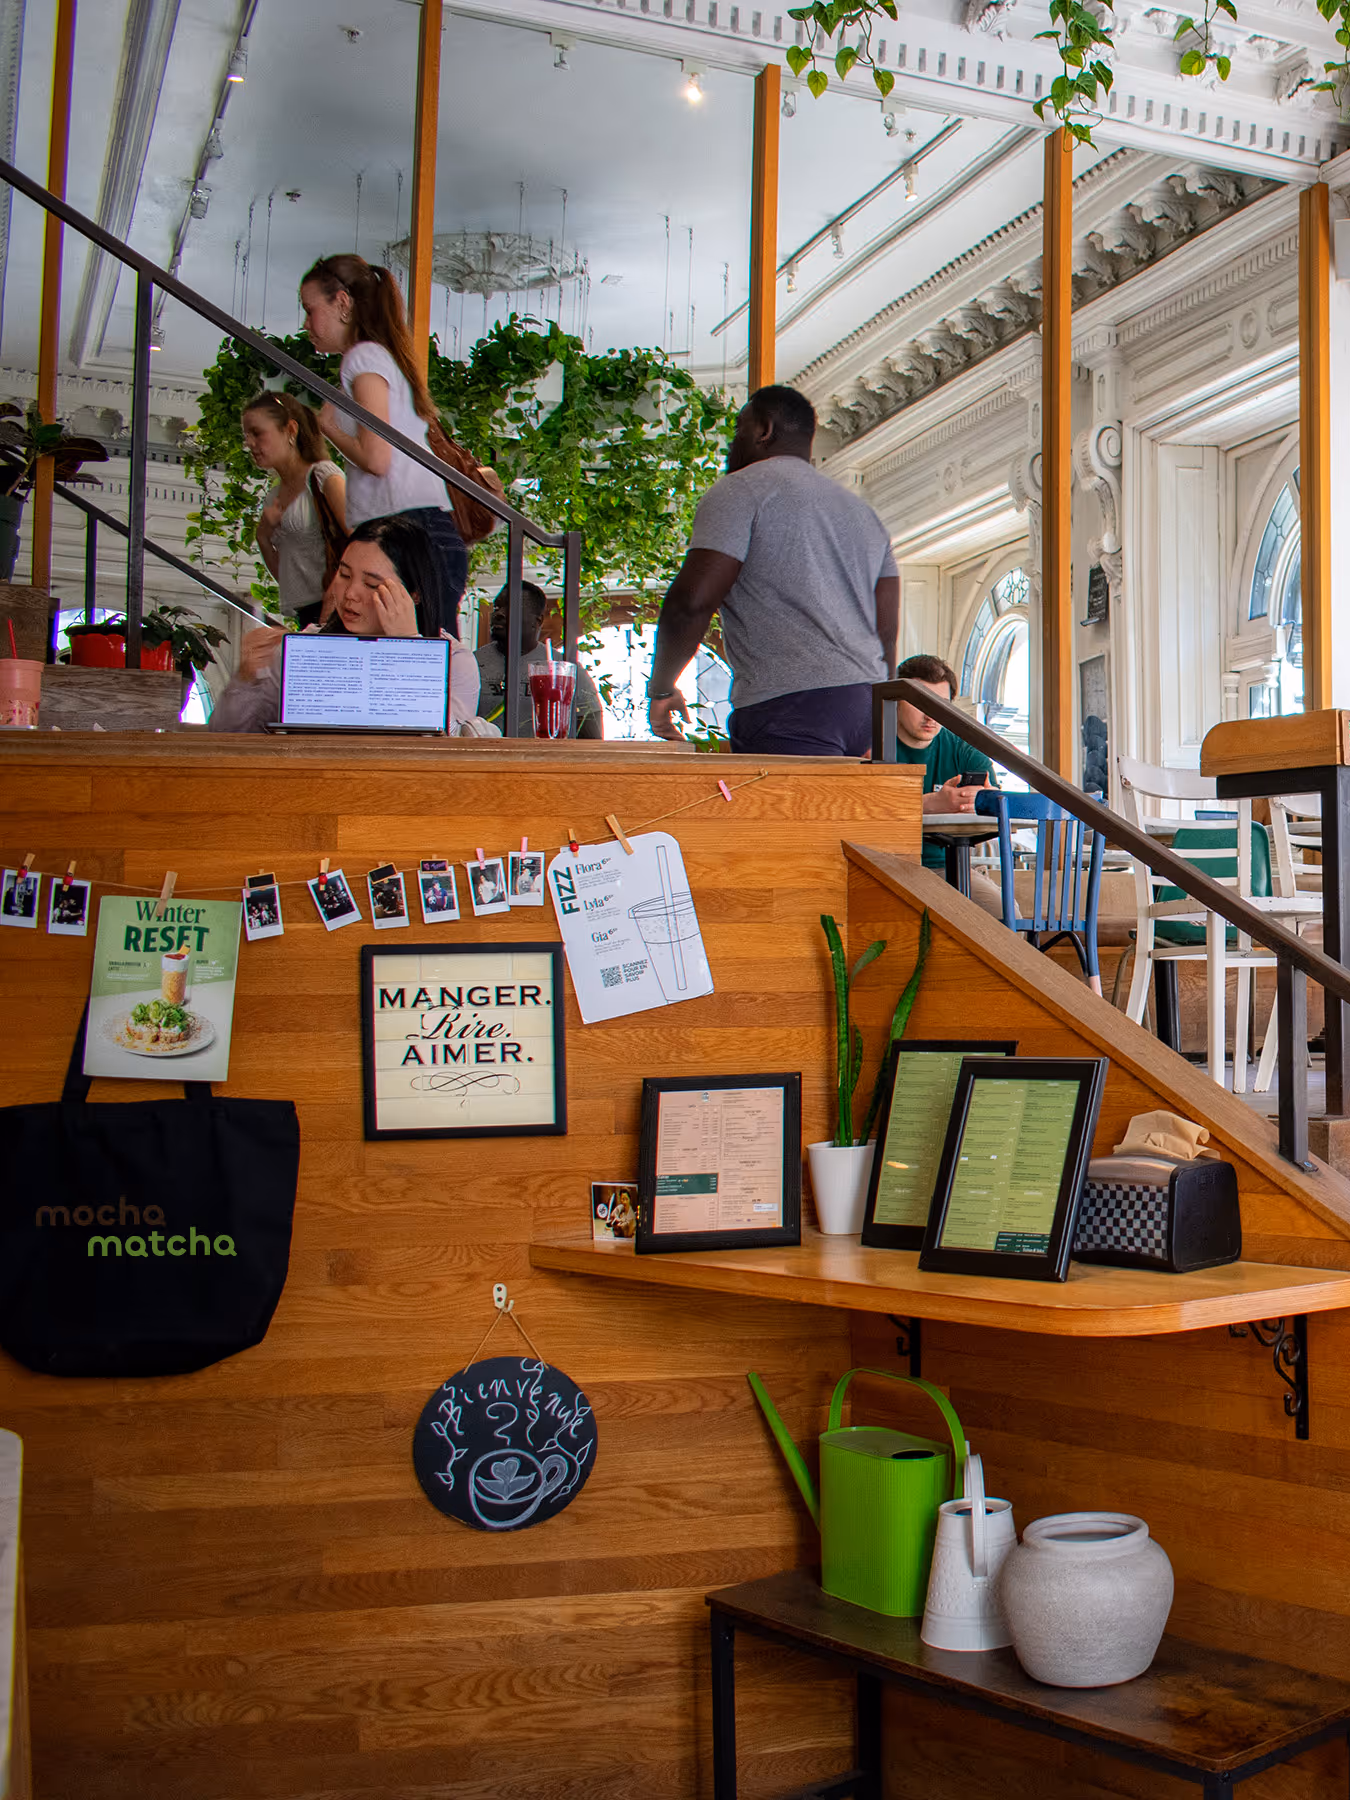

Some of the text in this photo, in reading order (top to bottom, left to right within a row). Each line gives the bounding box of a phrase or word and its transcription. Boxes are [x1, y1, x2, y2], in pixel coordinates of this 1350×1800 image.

[575, 862, 602, 875] Flora
[553, 867, 580, 915] FIZZ
[136, 900, 206, 924] Wnter
[584, 898, 604, 911] Lyla
[124, 925, 210, 952] RESET
[591, 931, 609, 943] Gia
[622, 959, 648, 969] SCANNEZ
[624, 966, 639, 974] POUR
[625, 970, 645, 978] SAVOIR
[379, 985, 552, 1008] MANGER.
[401, 1042, 534, 1066] AIMER.
[35, 1195, 166, 1227] mocha
[87, 1226, 237, 1257] matcha
